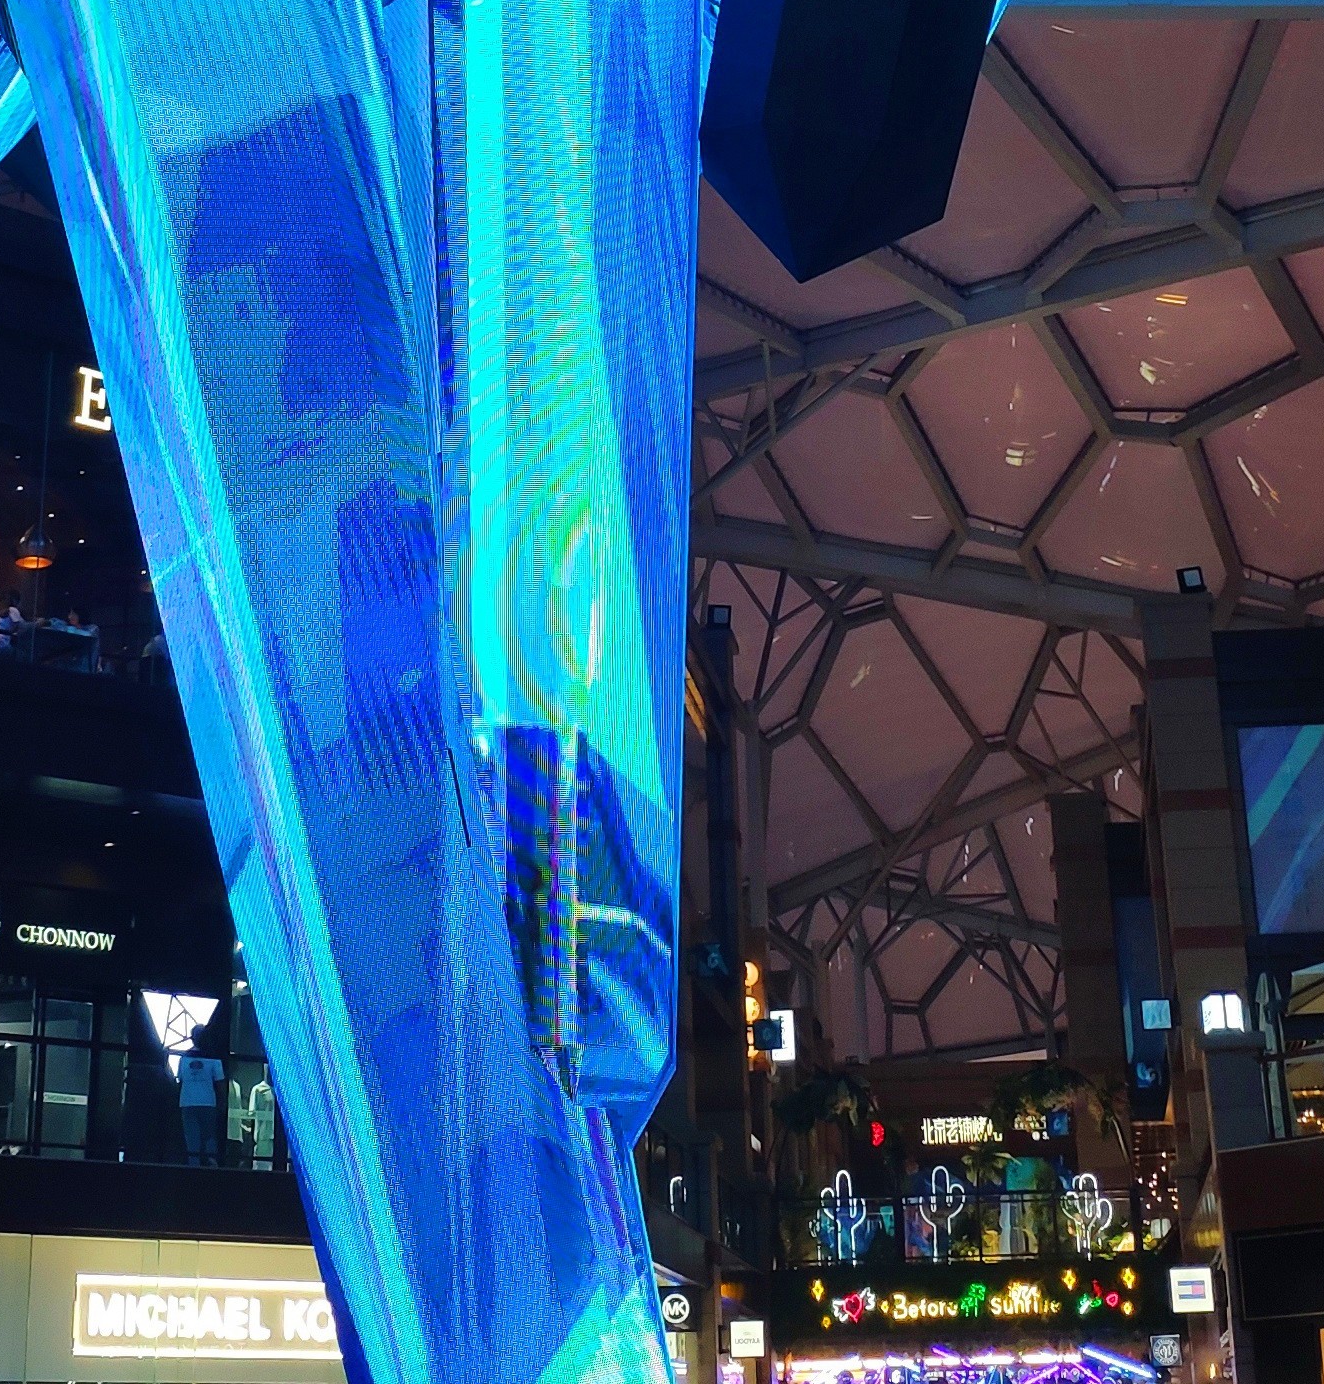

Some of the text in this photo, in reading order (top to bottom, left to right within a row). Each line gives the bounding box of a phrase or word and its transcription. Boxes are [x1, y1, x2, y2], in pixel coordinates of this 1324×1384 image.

[16, 924, 116, 952] CHONNOW
[86, 1291, 272, 1342] MICHAEL
[664, 1300, 687, 1317] MK
[892, 1294, 959, 1320] Before
